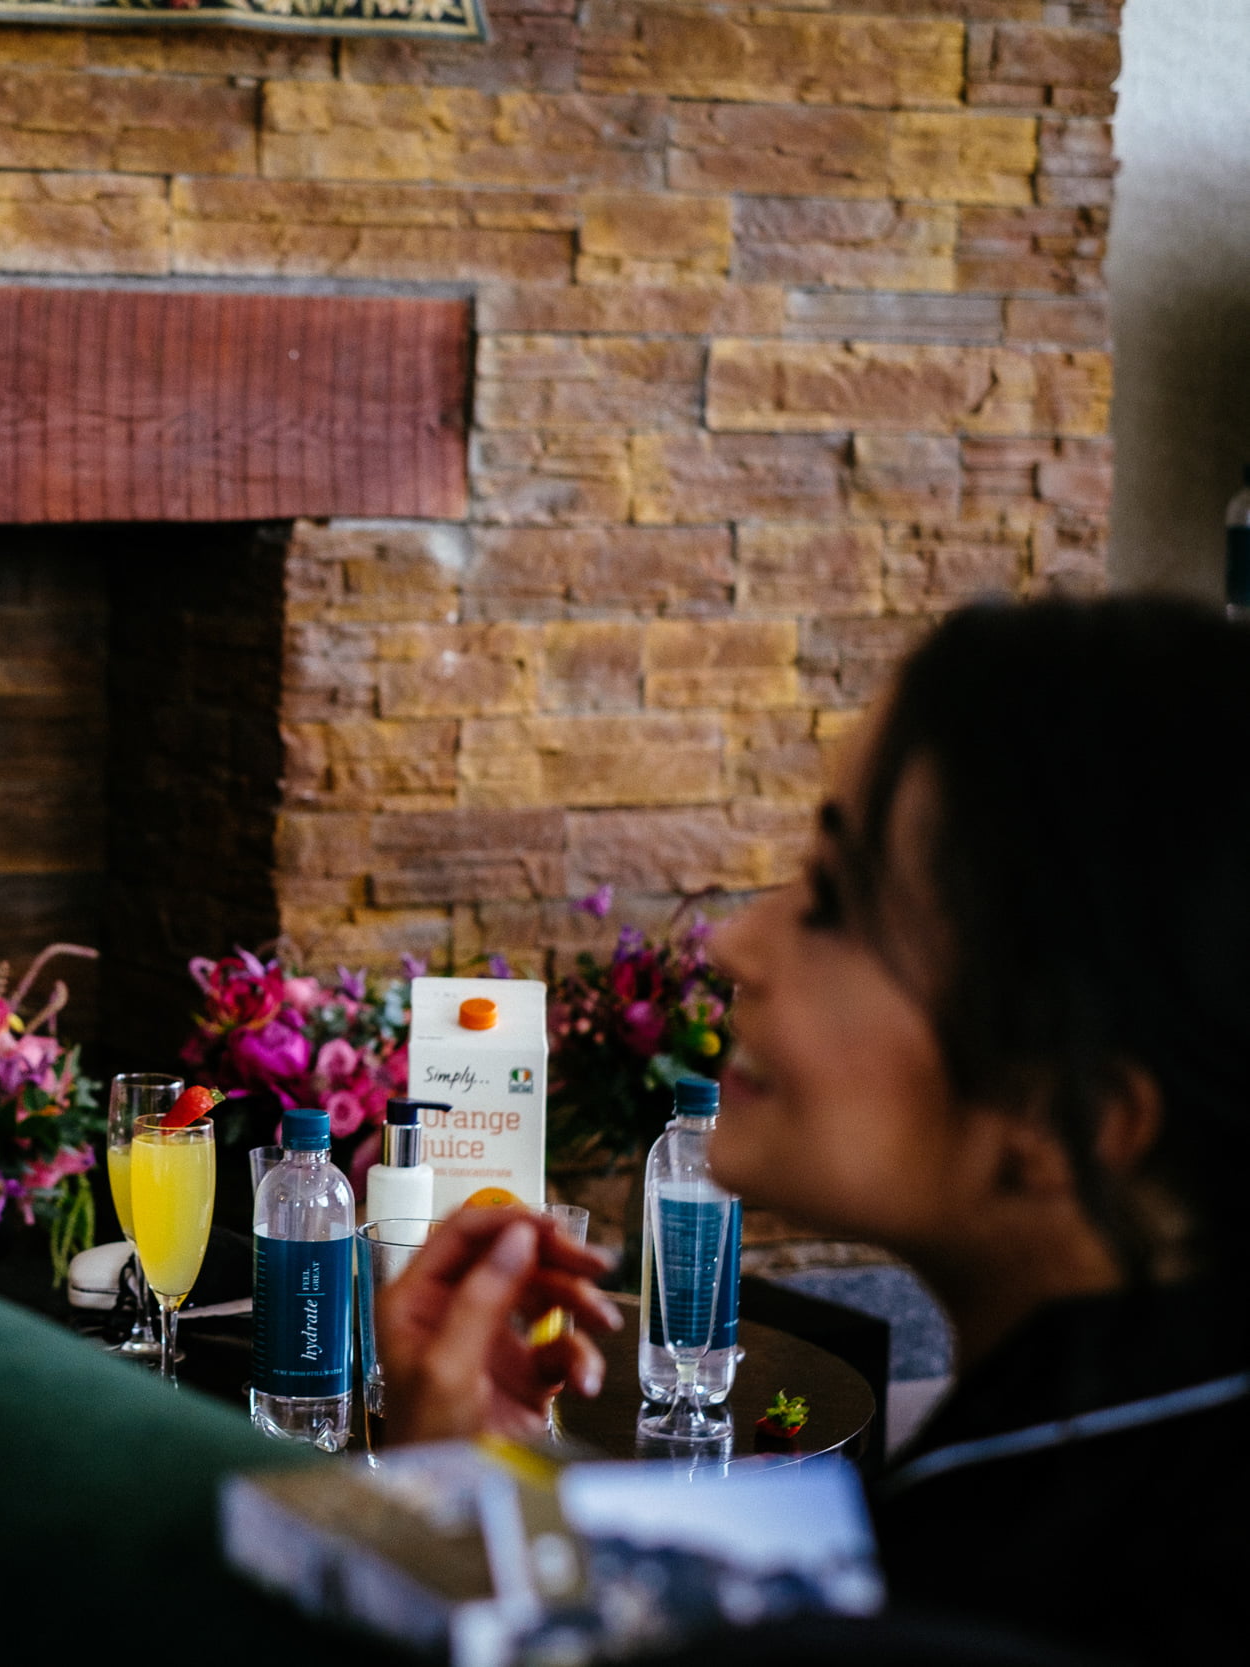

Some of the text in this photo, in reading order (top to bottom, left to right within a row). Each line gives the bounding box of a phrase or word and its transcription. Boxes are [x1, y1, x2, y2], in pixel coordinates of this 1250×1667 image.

[421, 1134, 485, 1162] juice
[302, 1268, 311, 1291] FEEL
[312, 1260, 321, 1291] GREAT
[300, 1298, 323, 1361] hydrate
